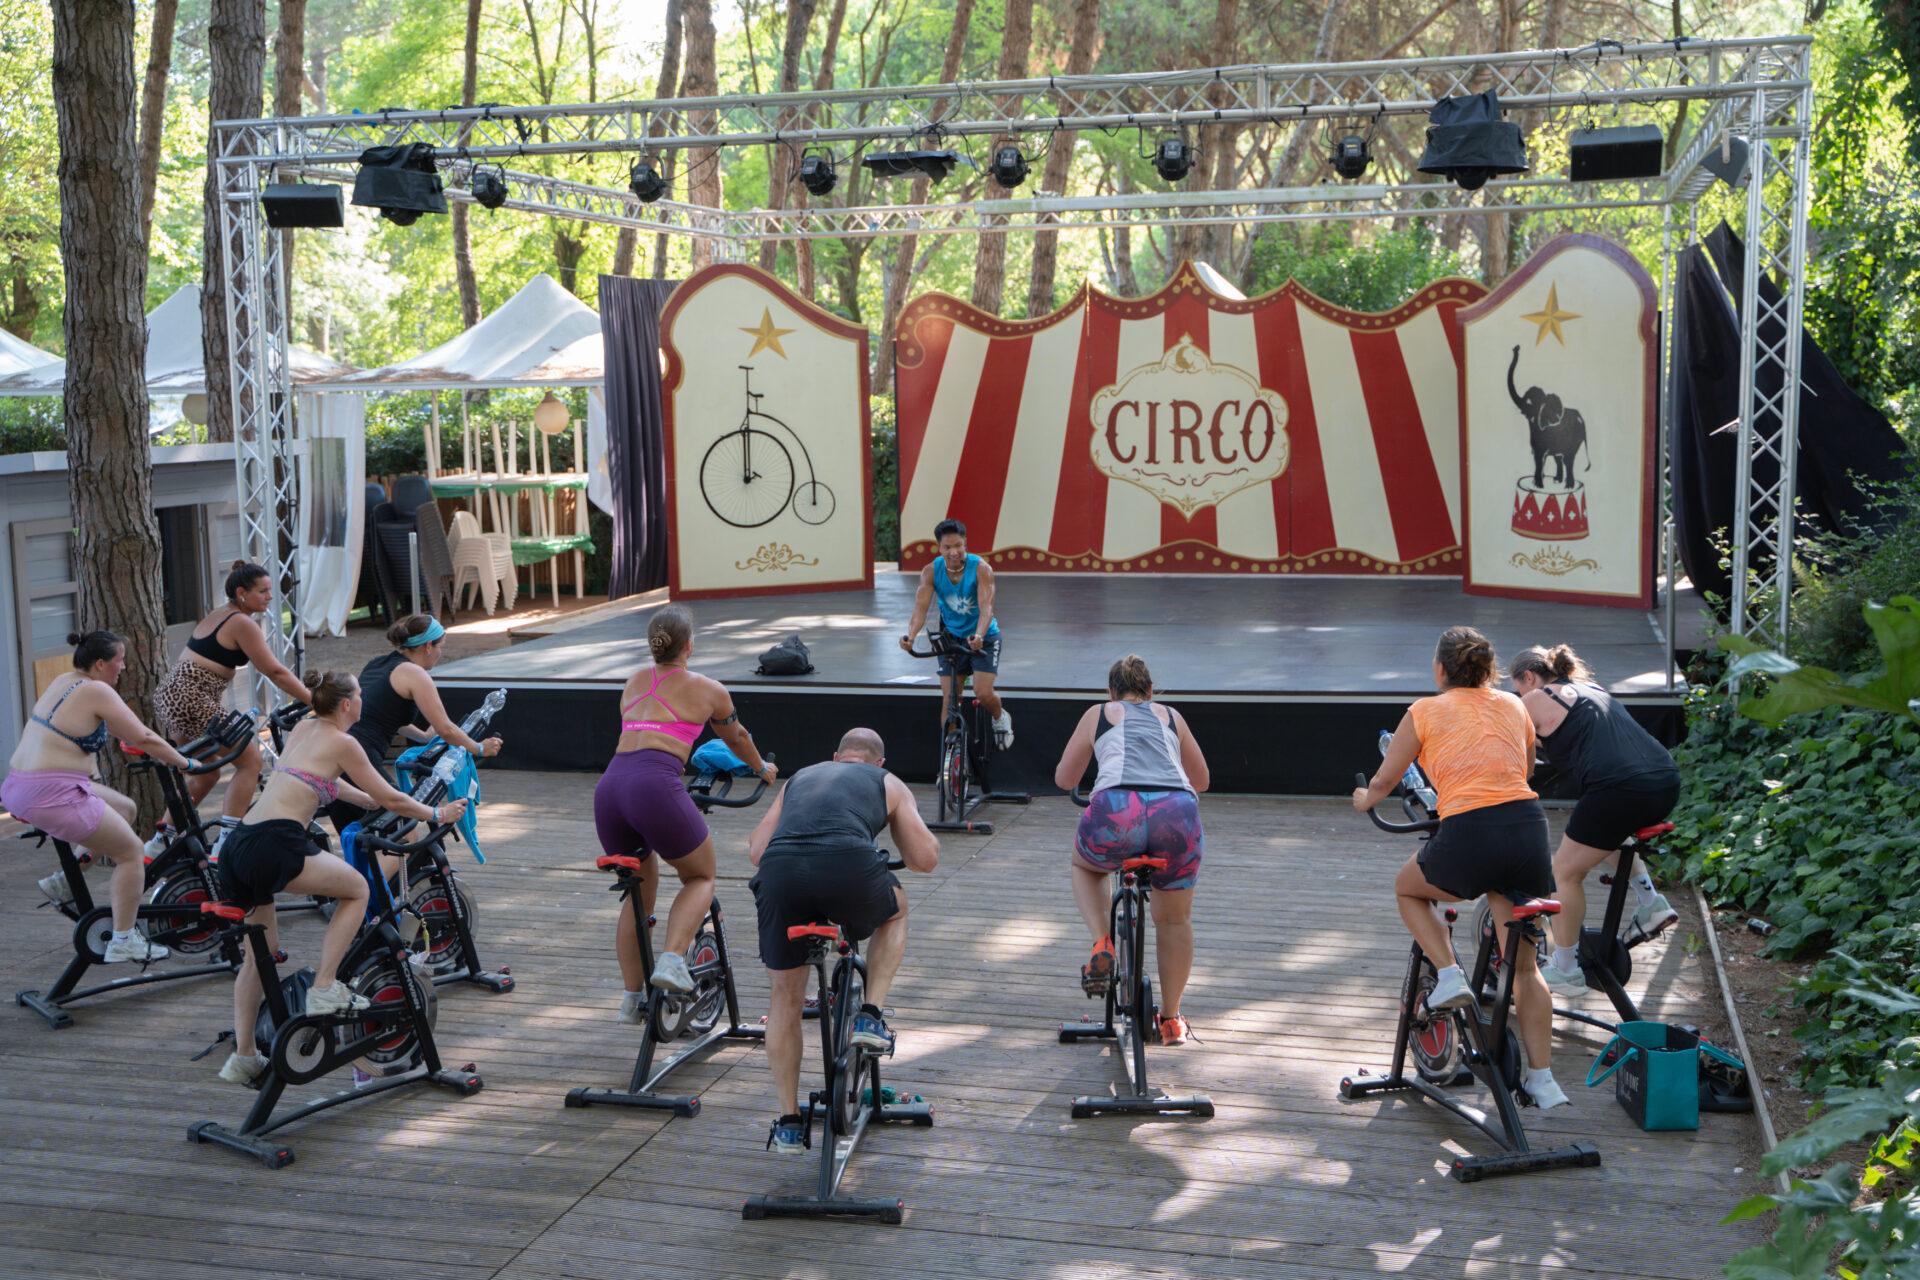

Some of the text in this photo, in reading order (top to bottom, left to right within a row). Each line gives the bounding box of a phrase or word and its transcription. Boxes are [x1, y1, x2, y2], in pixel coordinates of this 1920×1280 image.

[1105, 399, 1275, 464] CIRCO
[202, 868, 219, 901] SCHWI
[446, 875, 463, 919] SCHWINN
[401, 960, 421, 1009] SCHWINN
